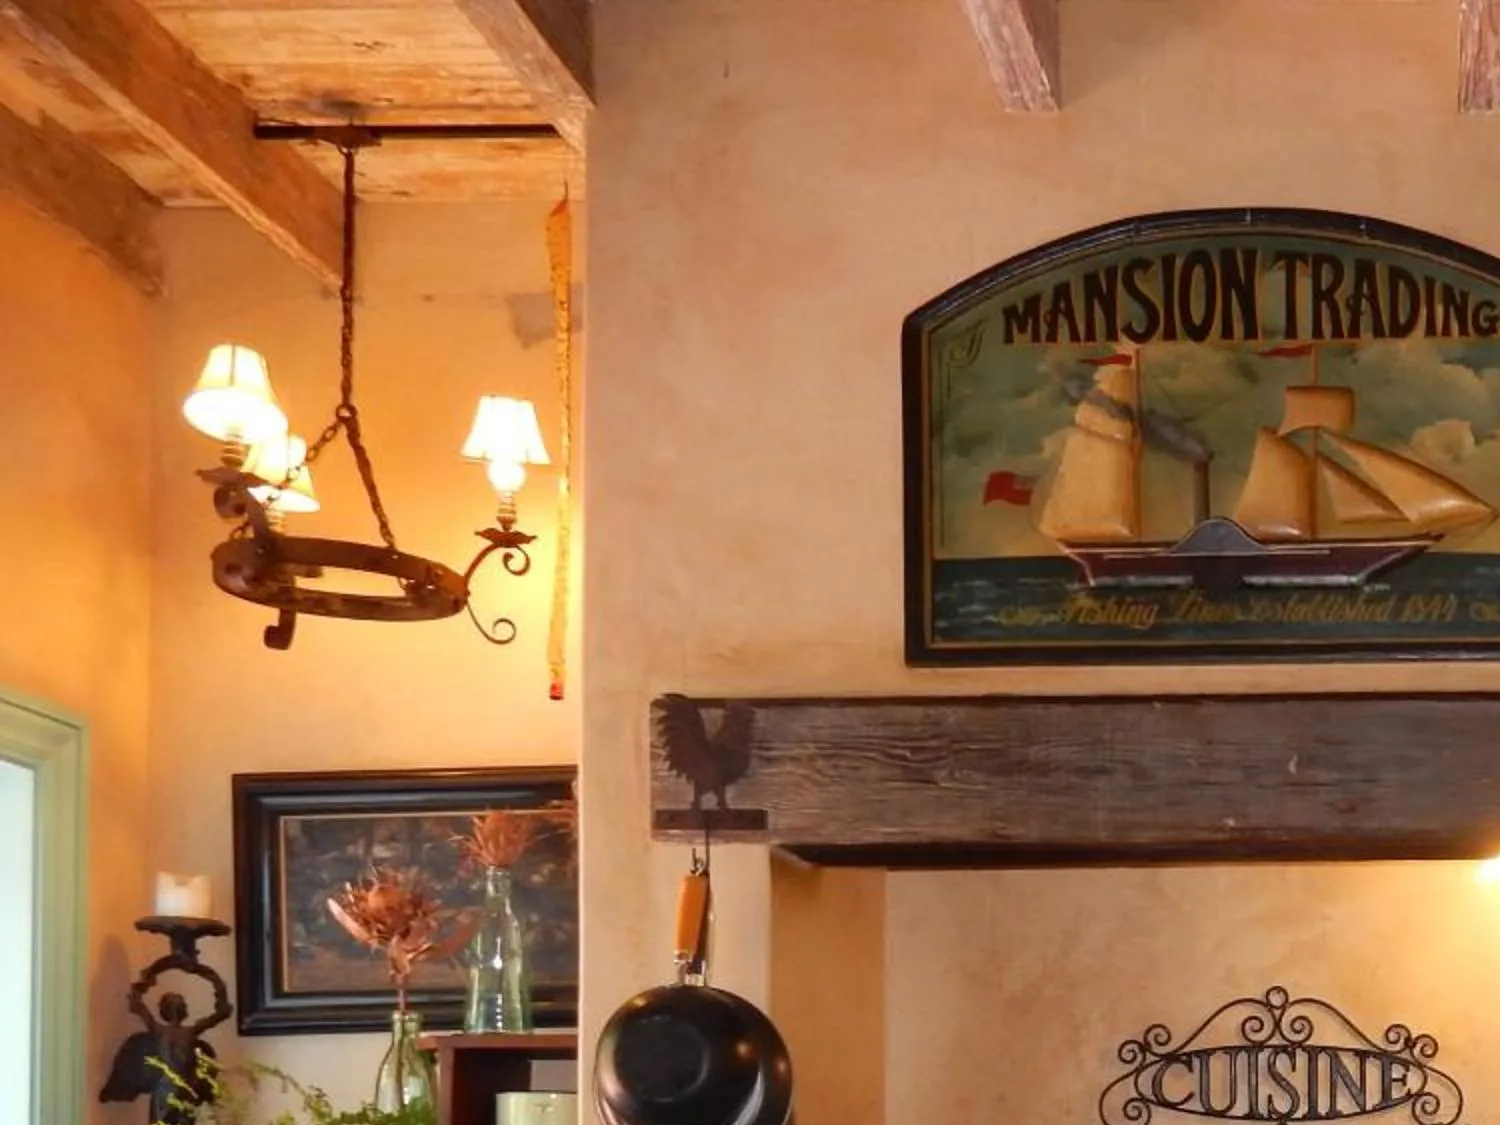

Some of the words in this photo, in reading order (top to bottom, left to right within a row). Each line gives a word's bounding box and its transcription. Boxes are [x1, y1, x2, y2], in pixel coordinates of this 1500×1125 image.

[1002, 247, 1260, 345] MANSION
[1272, 249, 1500, 340] TRADING
[1151, 1045, 1413, 1121] CUISINE
